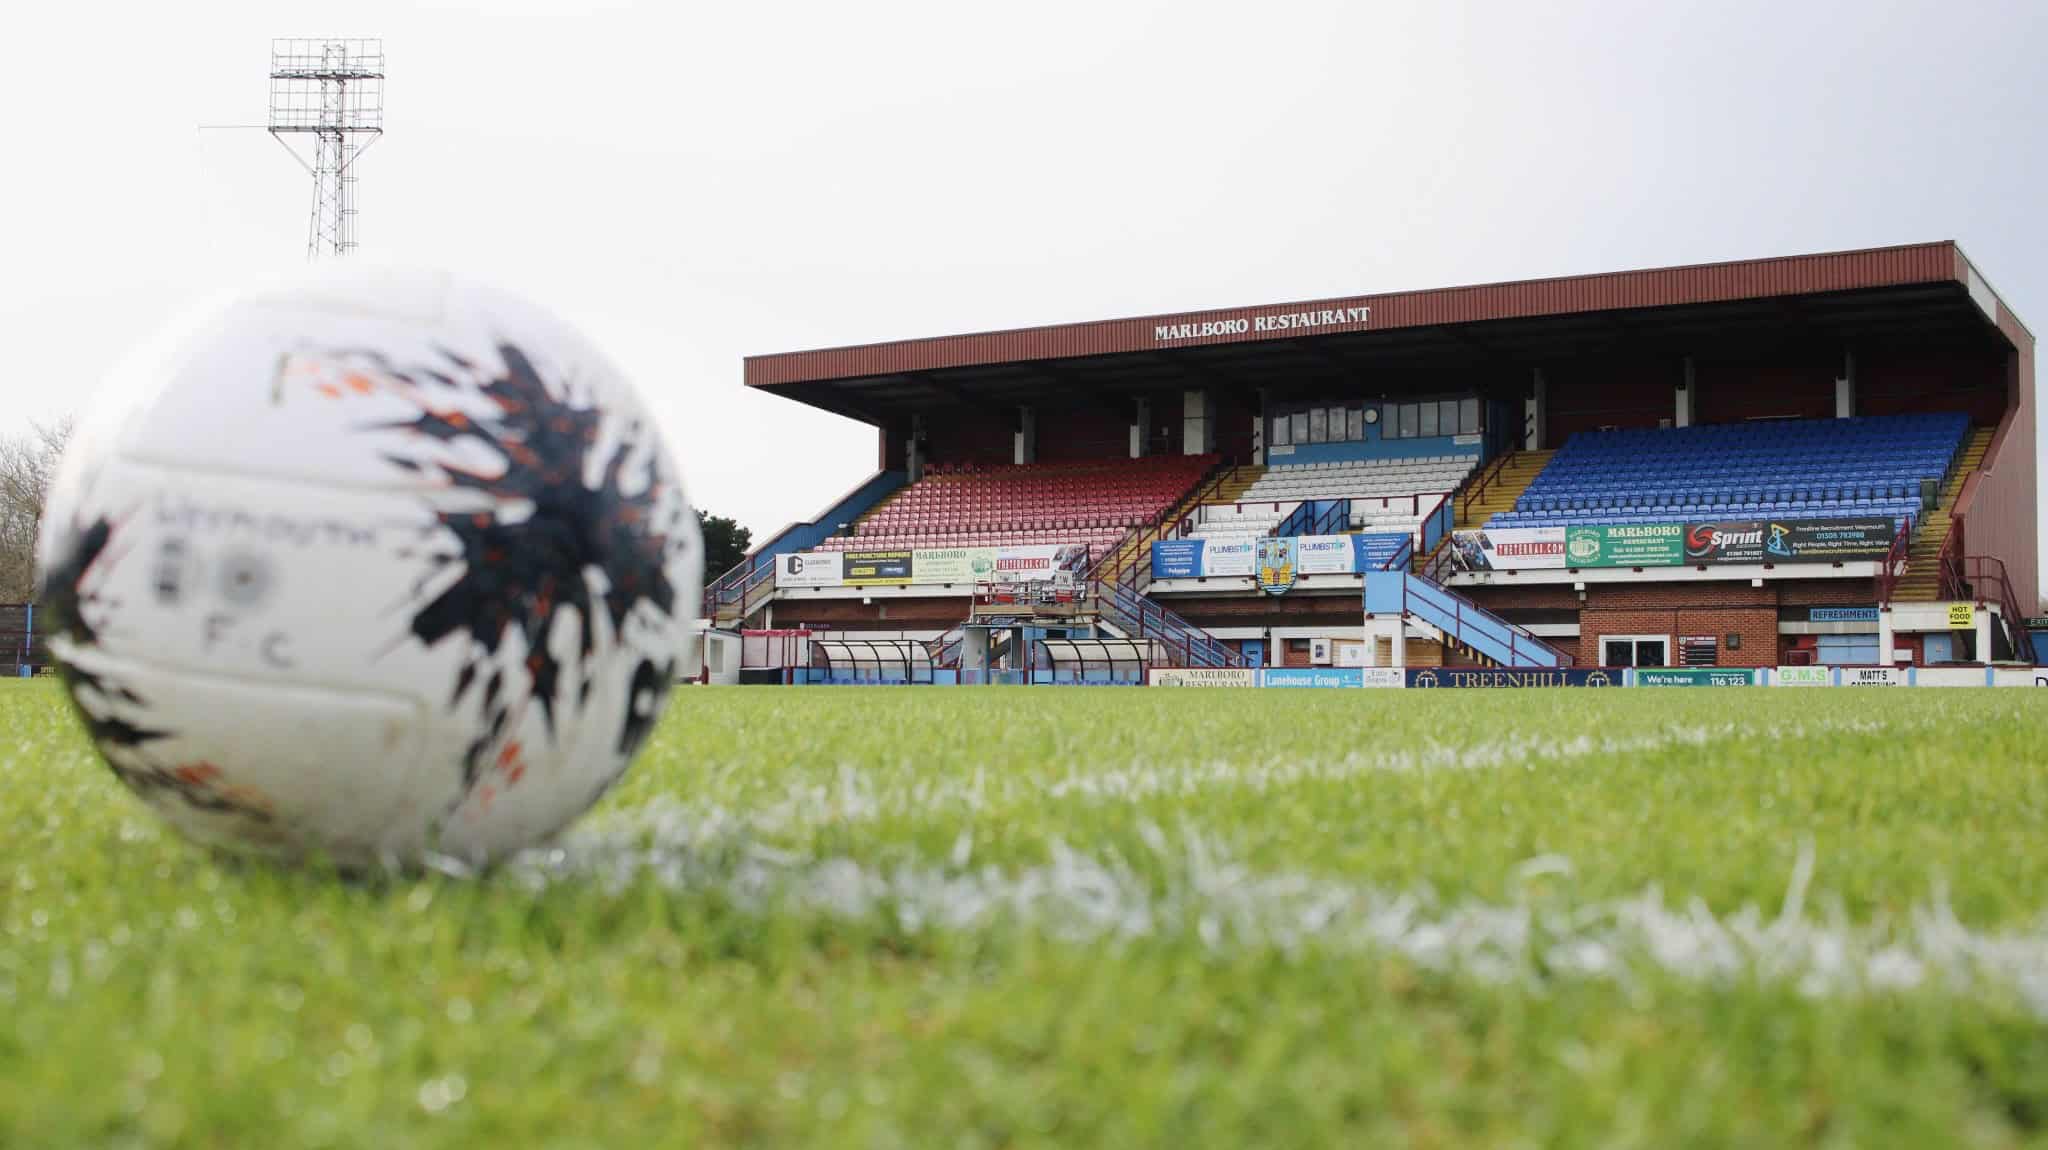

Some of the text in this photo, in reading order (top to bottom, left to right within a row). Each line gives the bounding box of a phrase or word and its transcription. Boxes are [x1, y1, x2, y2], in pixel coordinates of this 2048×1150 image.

[1155, 306, 1371, 341] MARLBORO RESTAURANT
[1607, 526, 1681, 537] MARLBORO
[1711, 530, 1763, 549] Sprint
[1812, 608, 1878, 620] REFRESHMENTS
[1189, 670, 1245, 680] MARLBORO
[1314, 674, 1340, 688] Group
[1449, 672, 1574, 688] TREENHILL
[1674, 675, 1693, 684] here
[1710, 676, 1745, 686] 116 123
